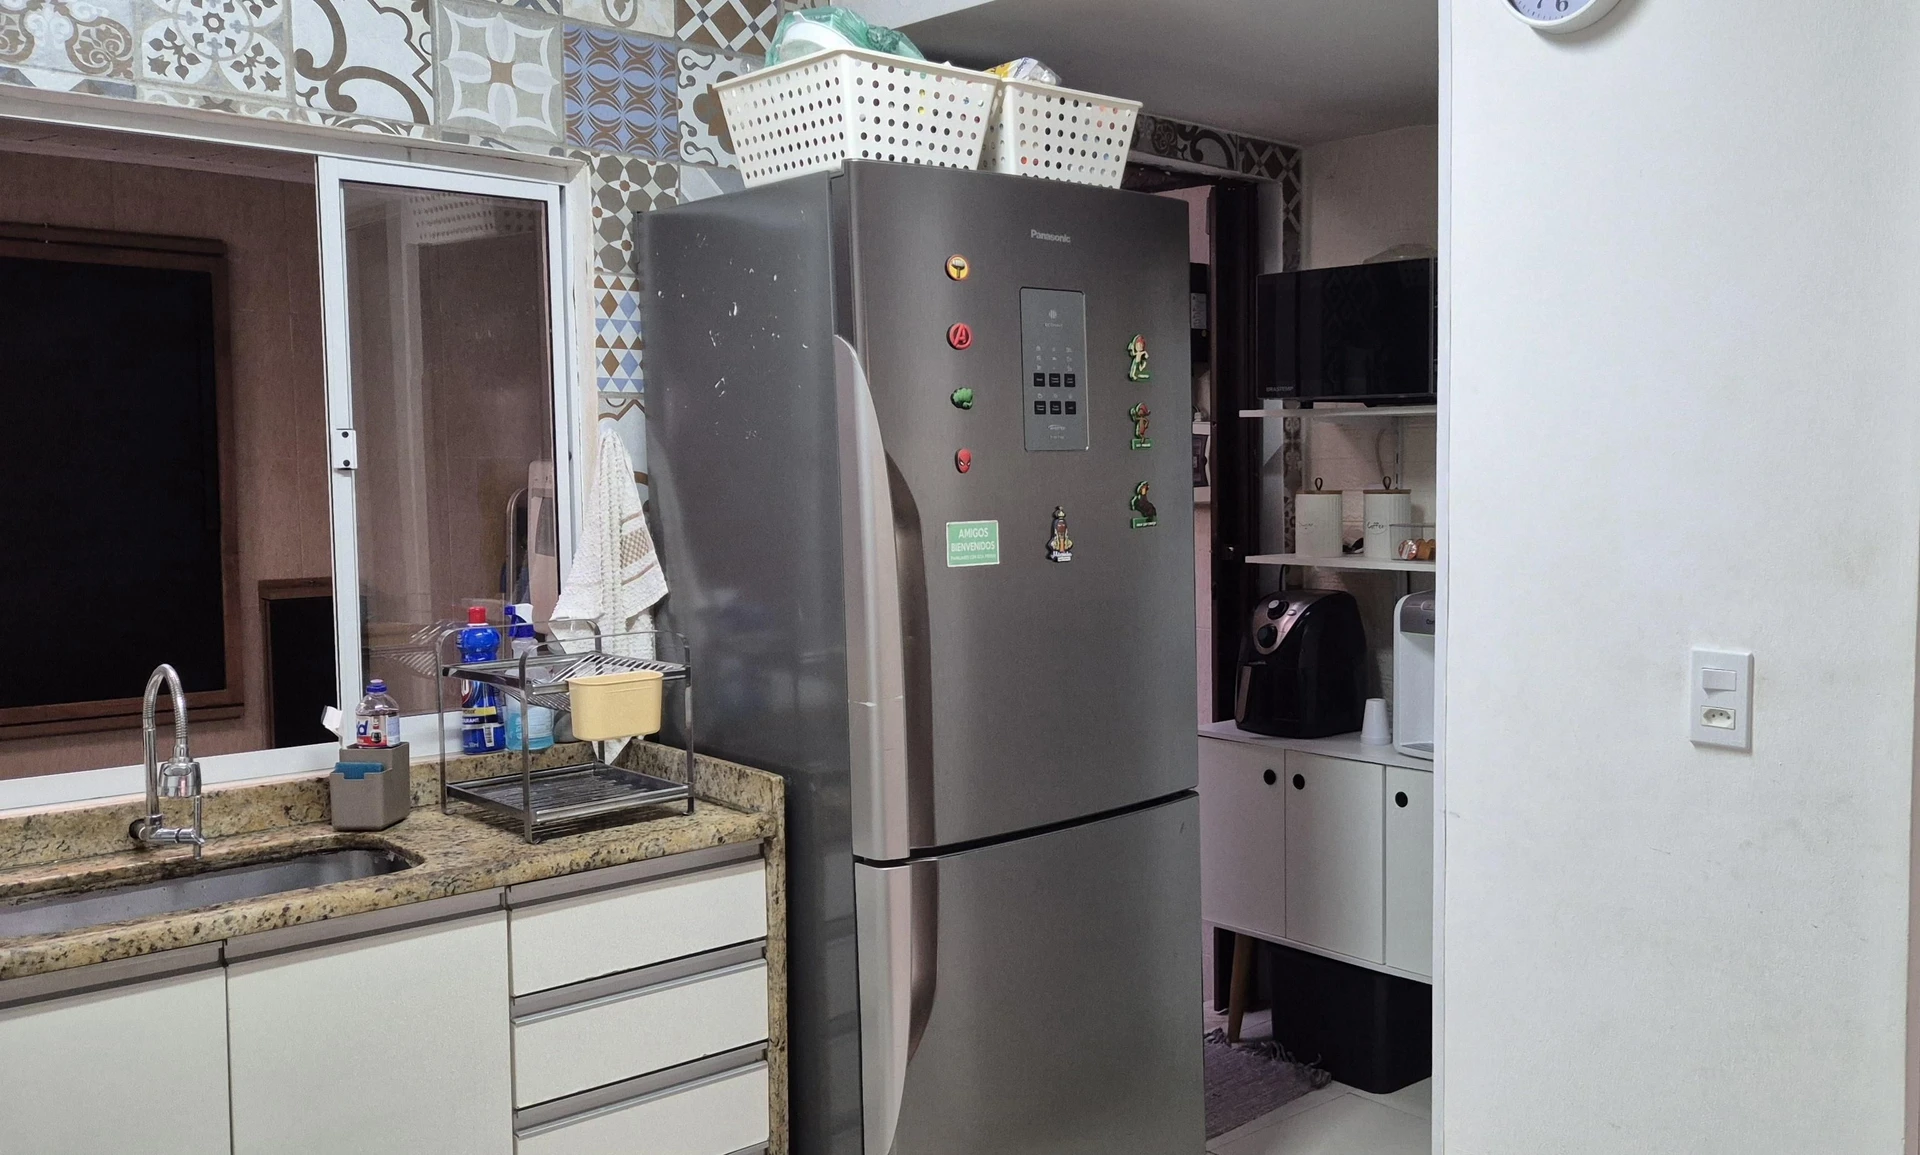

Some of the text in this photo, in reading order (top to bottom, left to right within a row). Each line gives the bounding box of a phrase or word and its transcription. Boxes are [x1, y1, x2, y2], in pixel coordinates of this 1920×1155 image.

[1031, 228, 1071, 243] Panasonic
[958, 527, 989, 539] AMIGOS
[950, 540, 995, 552] BIENVENIDOS
